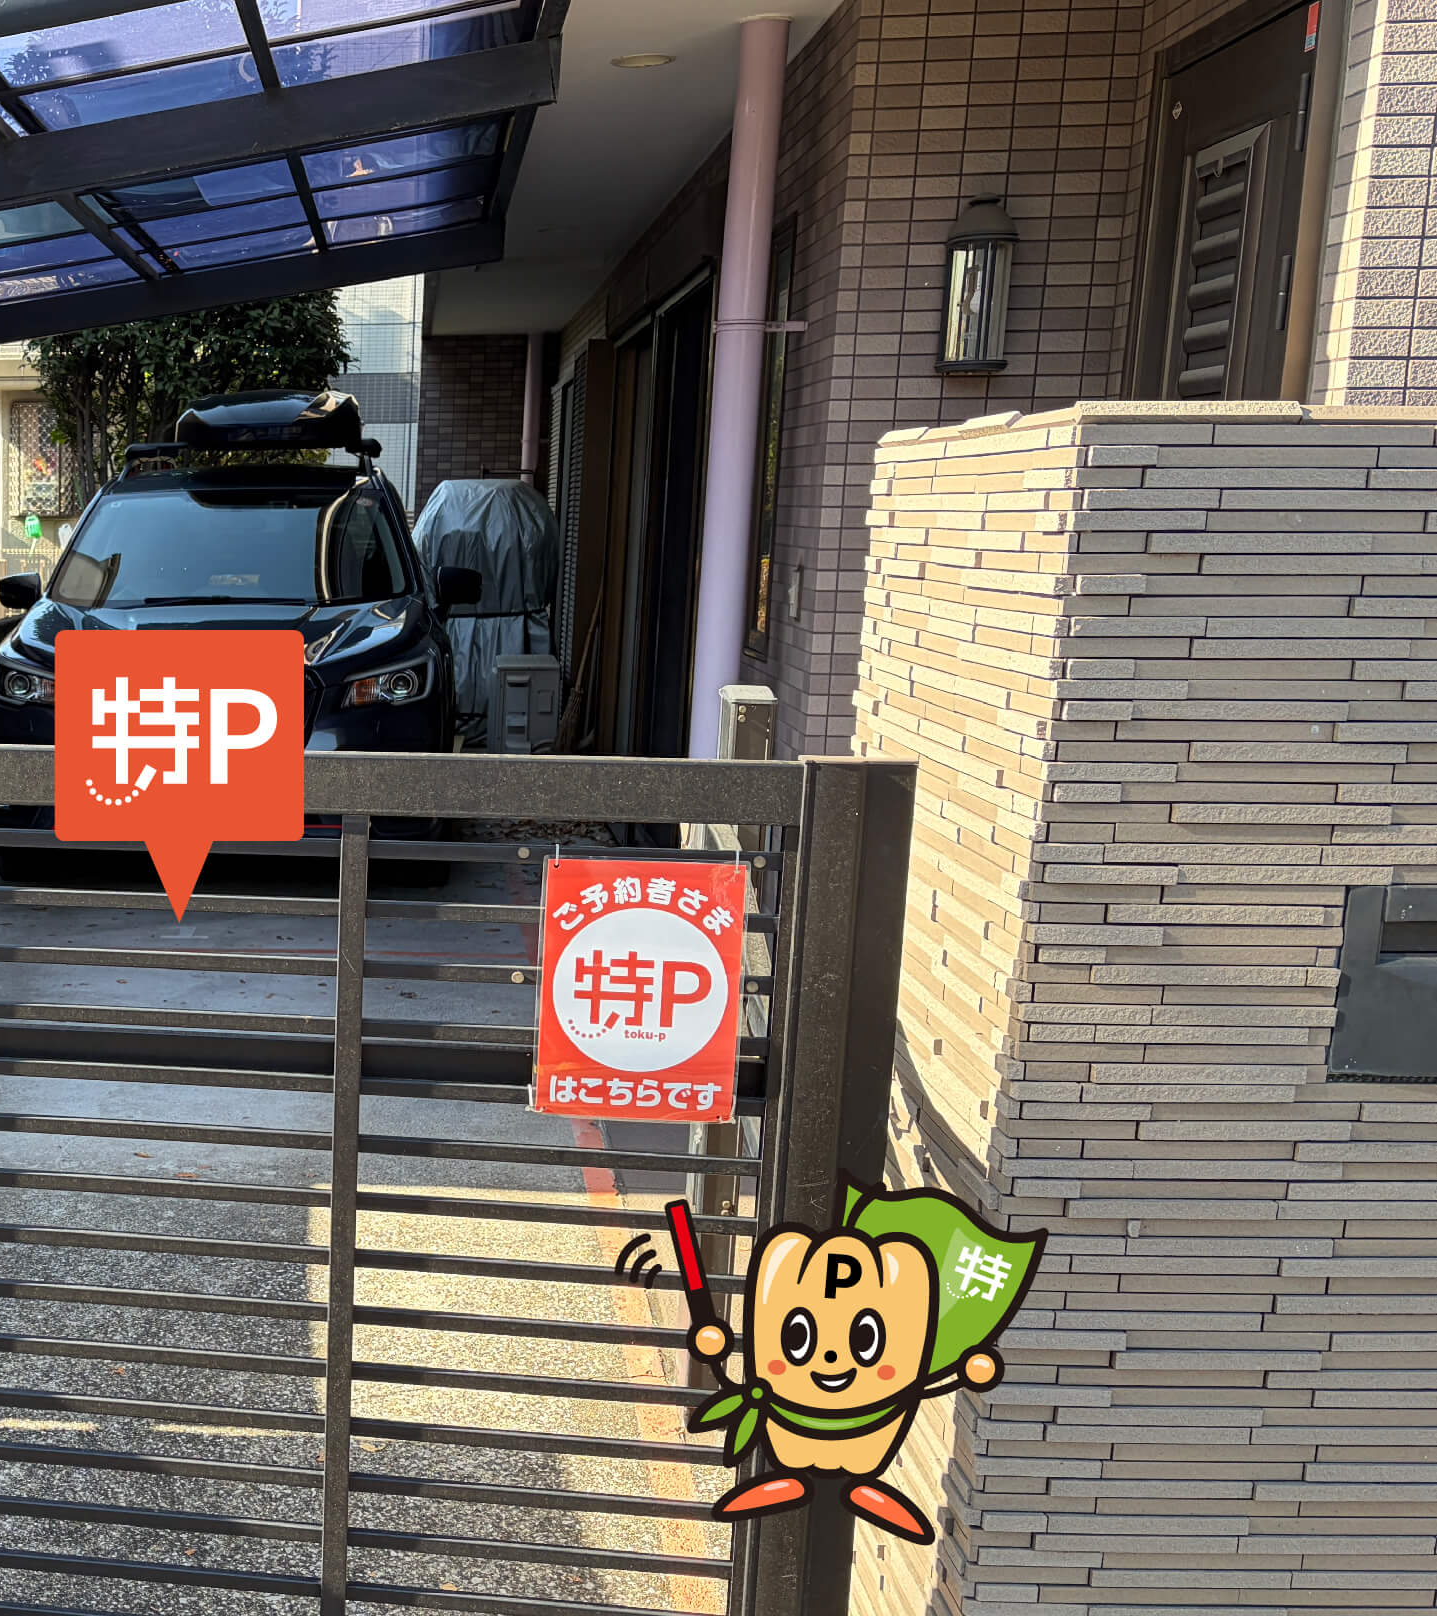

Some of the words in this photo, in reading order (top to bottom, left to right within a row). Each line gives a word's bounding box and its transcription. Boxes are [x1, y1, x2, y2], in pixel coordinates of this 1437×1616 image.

[552, 876, 735, 935] ご予約者さま
[573, 950, 712, 1029] 特P
[624, 1029, 666, 1042] toku-p
[549, 1074, 722, 1111] はこちらです
